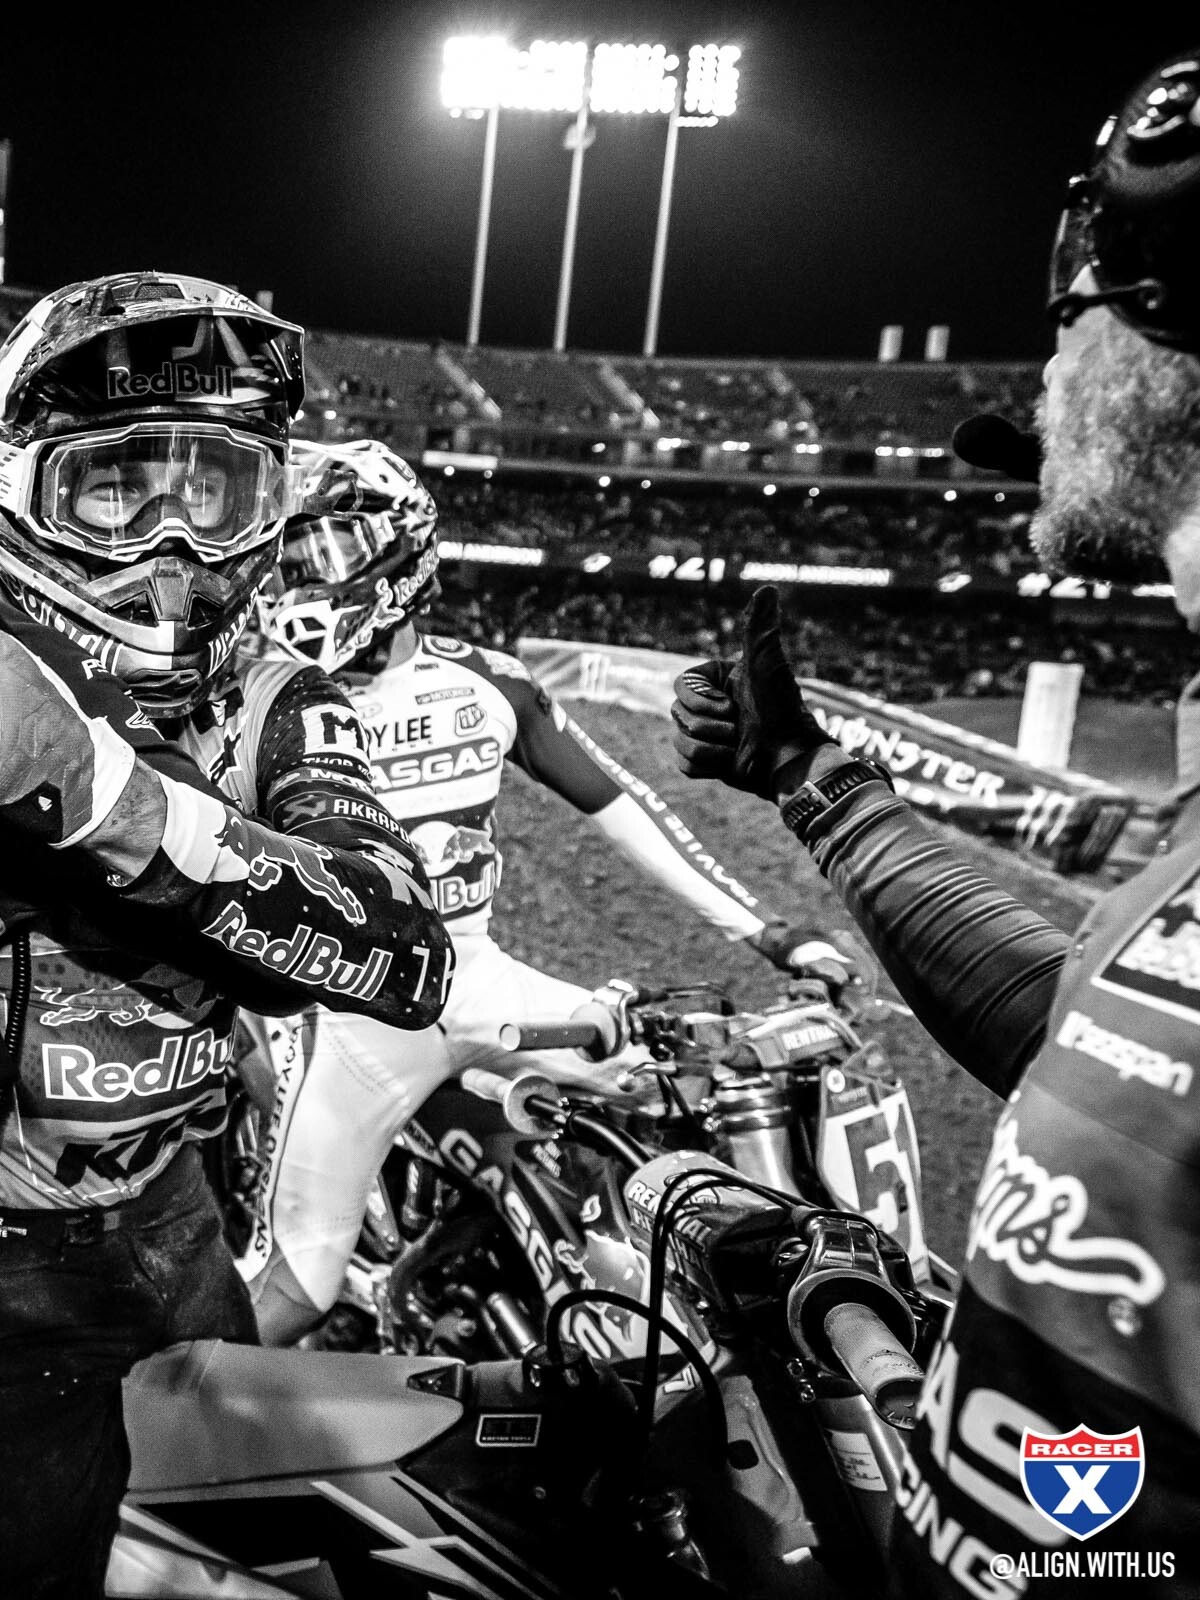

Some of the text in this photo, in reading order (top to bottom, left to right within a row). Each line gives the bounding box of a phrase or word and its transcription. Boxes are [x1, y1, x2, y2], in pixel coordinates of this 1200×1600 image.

[107, 362, 233, 399] Red Bull
[394, 715, 432, 745] LEE
[333, 798, 417, 850] AKRAPO
[439, 860, 496, 915] Bull
[201, 900, 394, 1001] Red Bull
[41, 1018, 236, 1103] Red Bu
